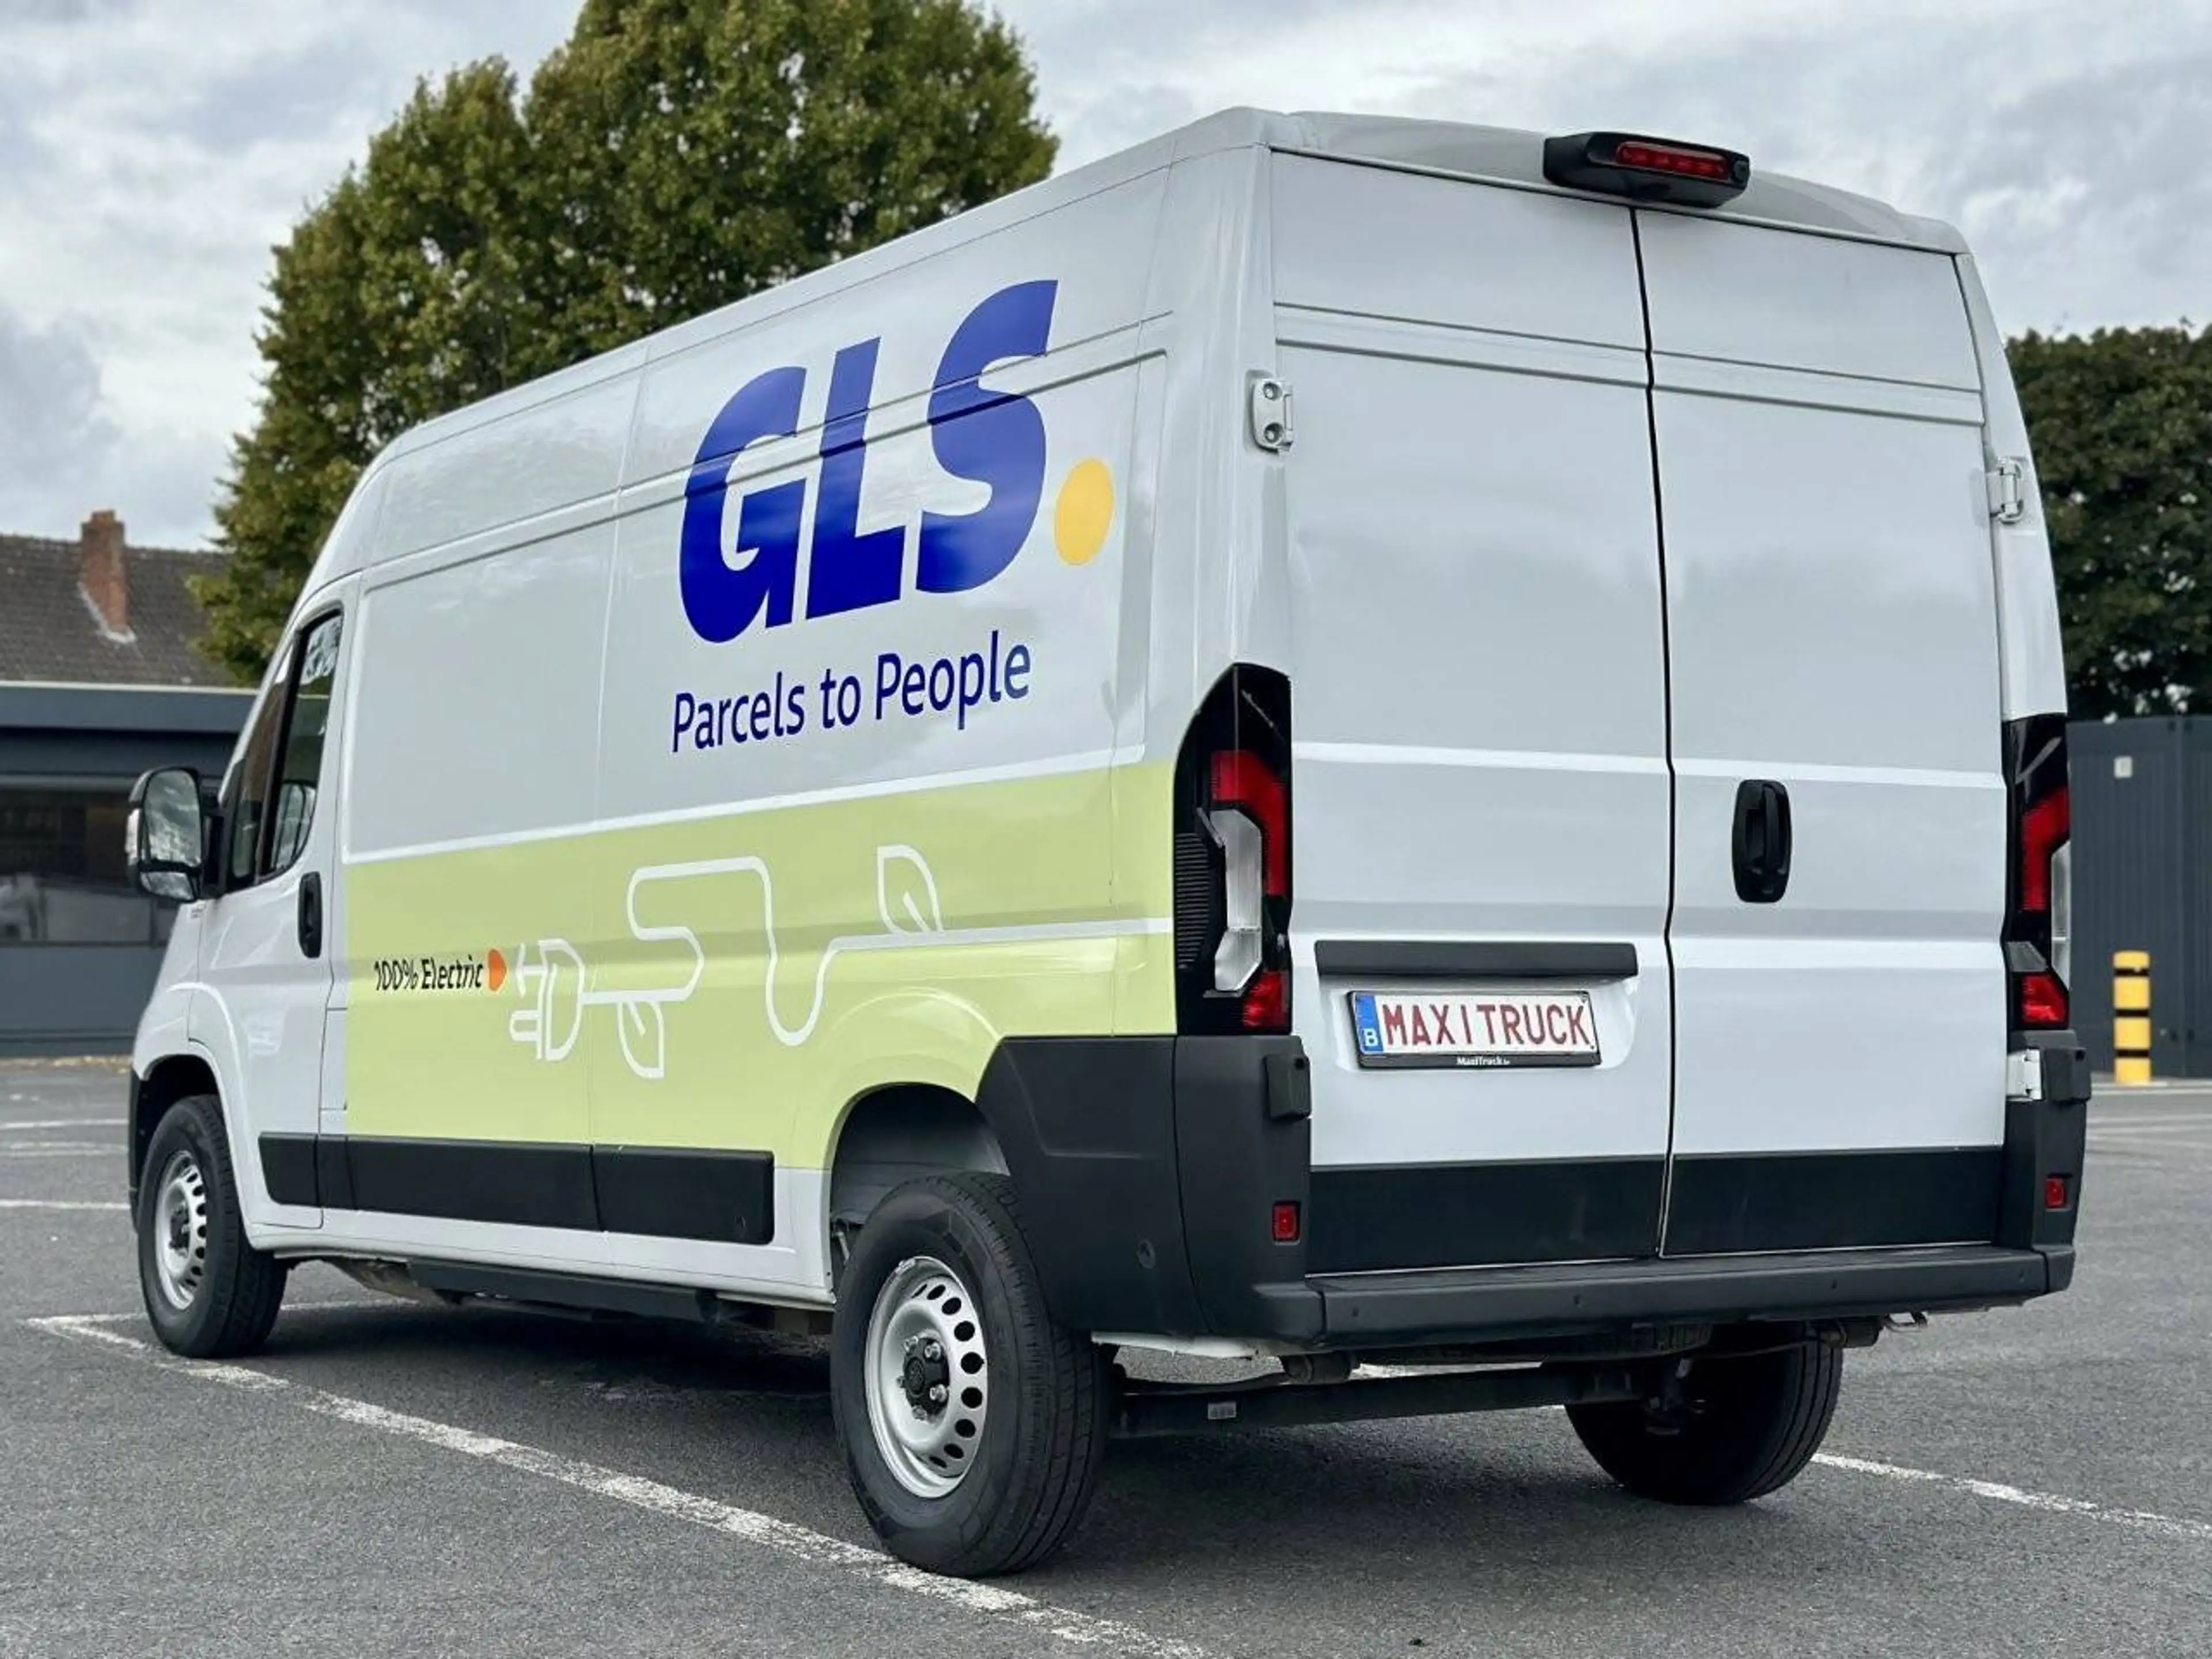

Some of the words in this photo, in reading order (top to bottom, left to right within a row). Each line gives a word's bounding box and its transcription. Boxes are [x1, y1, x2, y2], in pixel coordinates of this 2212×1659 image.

[672, 671, 805, 753] Parcels
[820, 668, 861, 728] to
[876, 630, 1031, 730] People
[373, 959, 419, 991] 100%
[421, 953, 483, 990] Electric
[1365, 1028, 1378, 1047] B
[1382, 1003, 1591, 1046] MAXITRUCK
